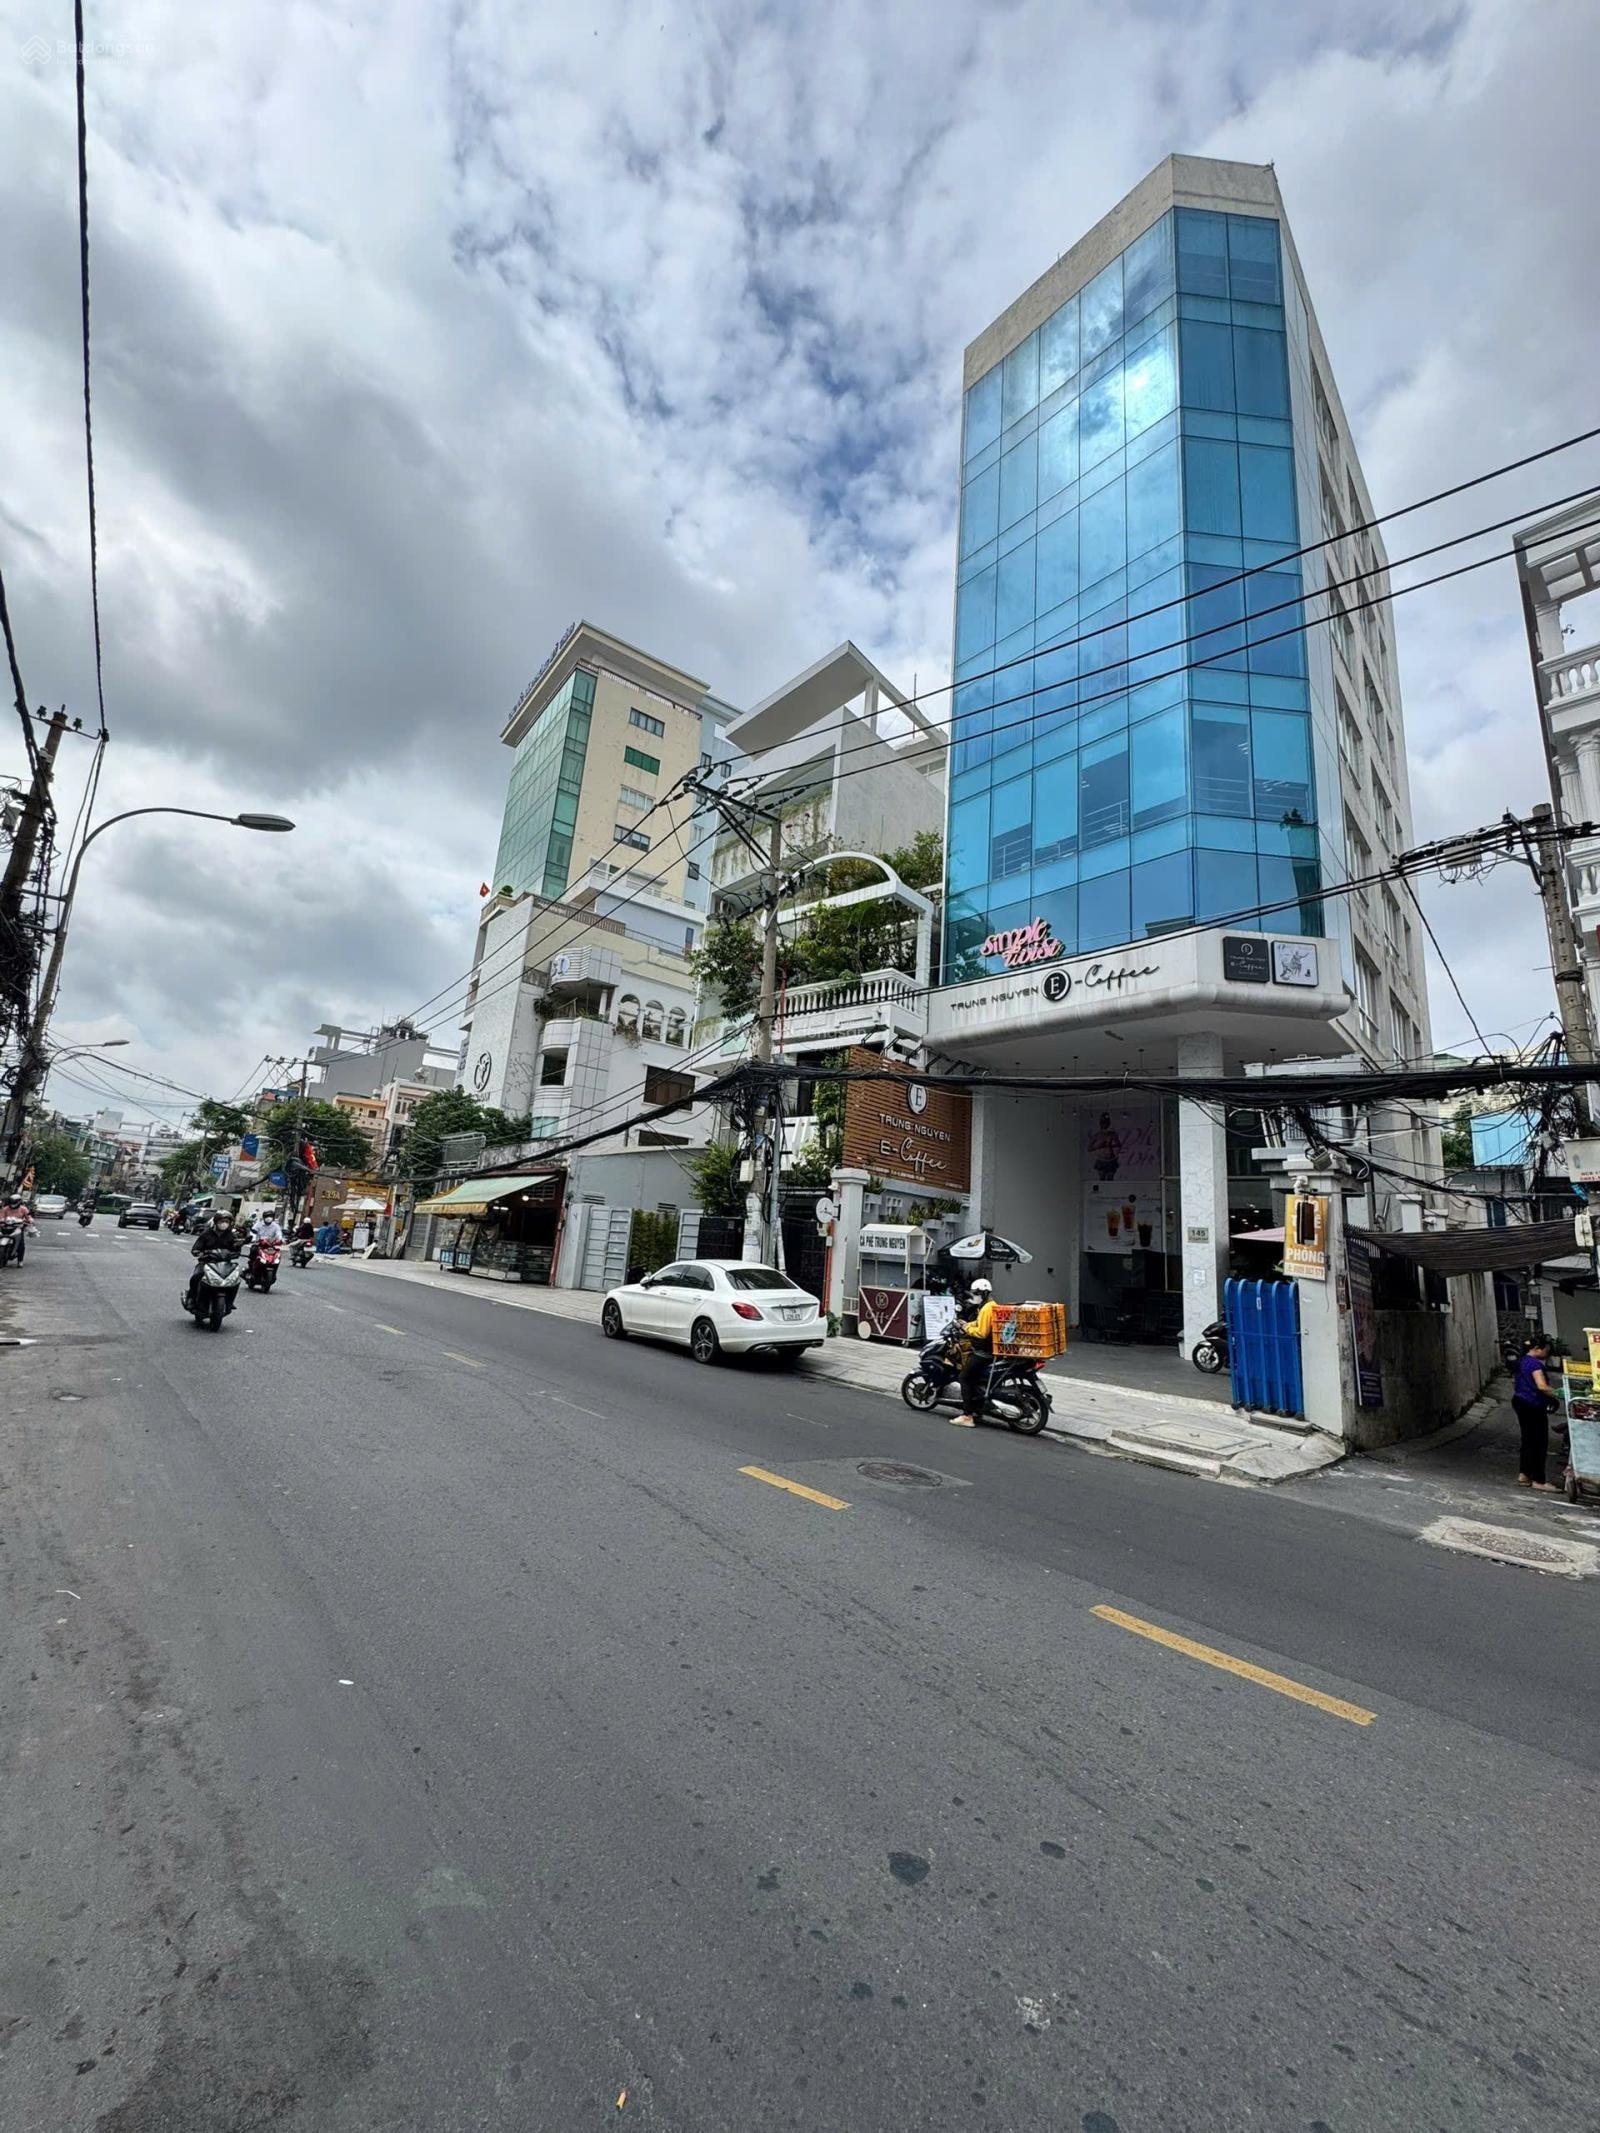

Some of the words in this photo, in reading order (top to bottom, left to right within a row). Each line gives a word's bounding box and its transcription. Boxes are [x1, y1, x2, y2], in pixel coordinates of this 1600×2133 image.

[980, 915, 1048, 956] simple
[1001, 937, 1064, 968] twist
[950, 997, 987, 1011] TRUNG
[991, 986, 1039, 1006] NGUYEN
[879, 1113, 911, 1131] TRUNG
[914, 1124, 951, 1142] NGUYEN
[1286, 1246, 1325, 1264] PHÒNG
